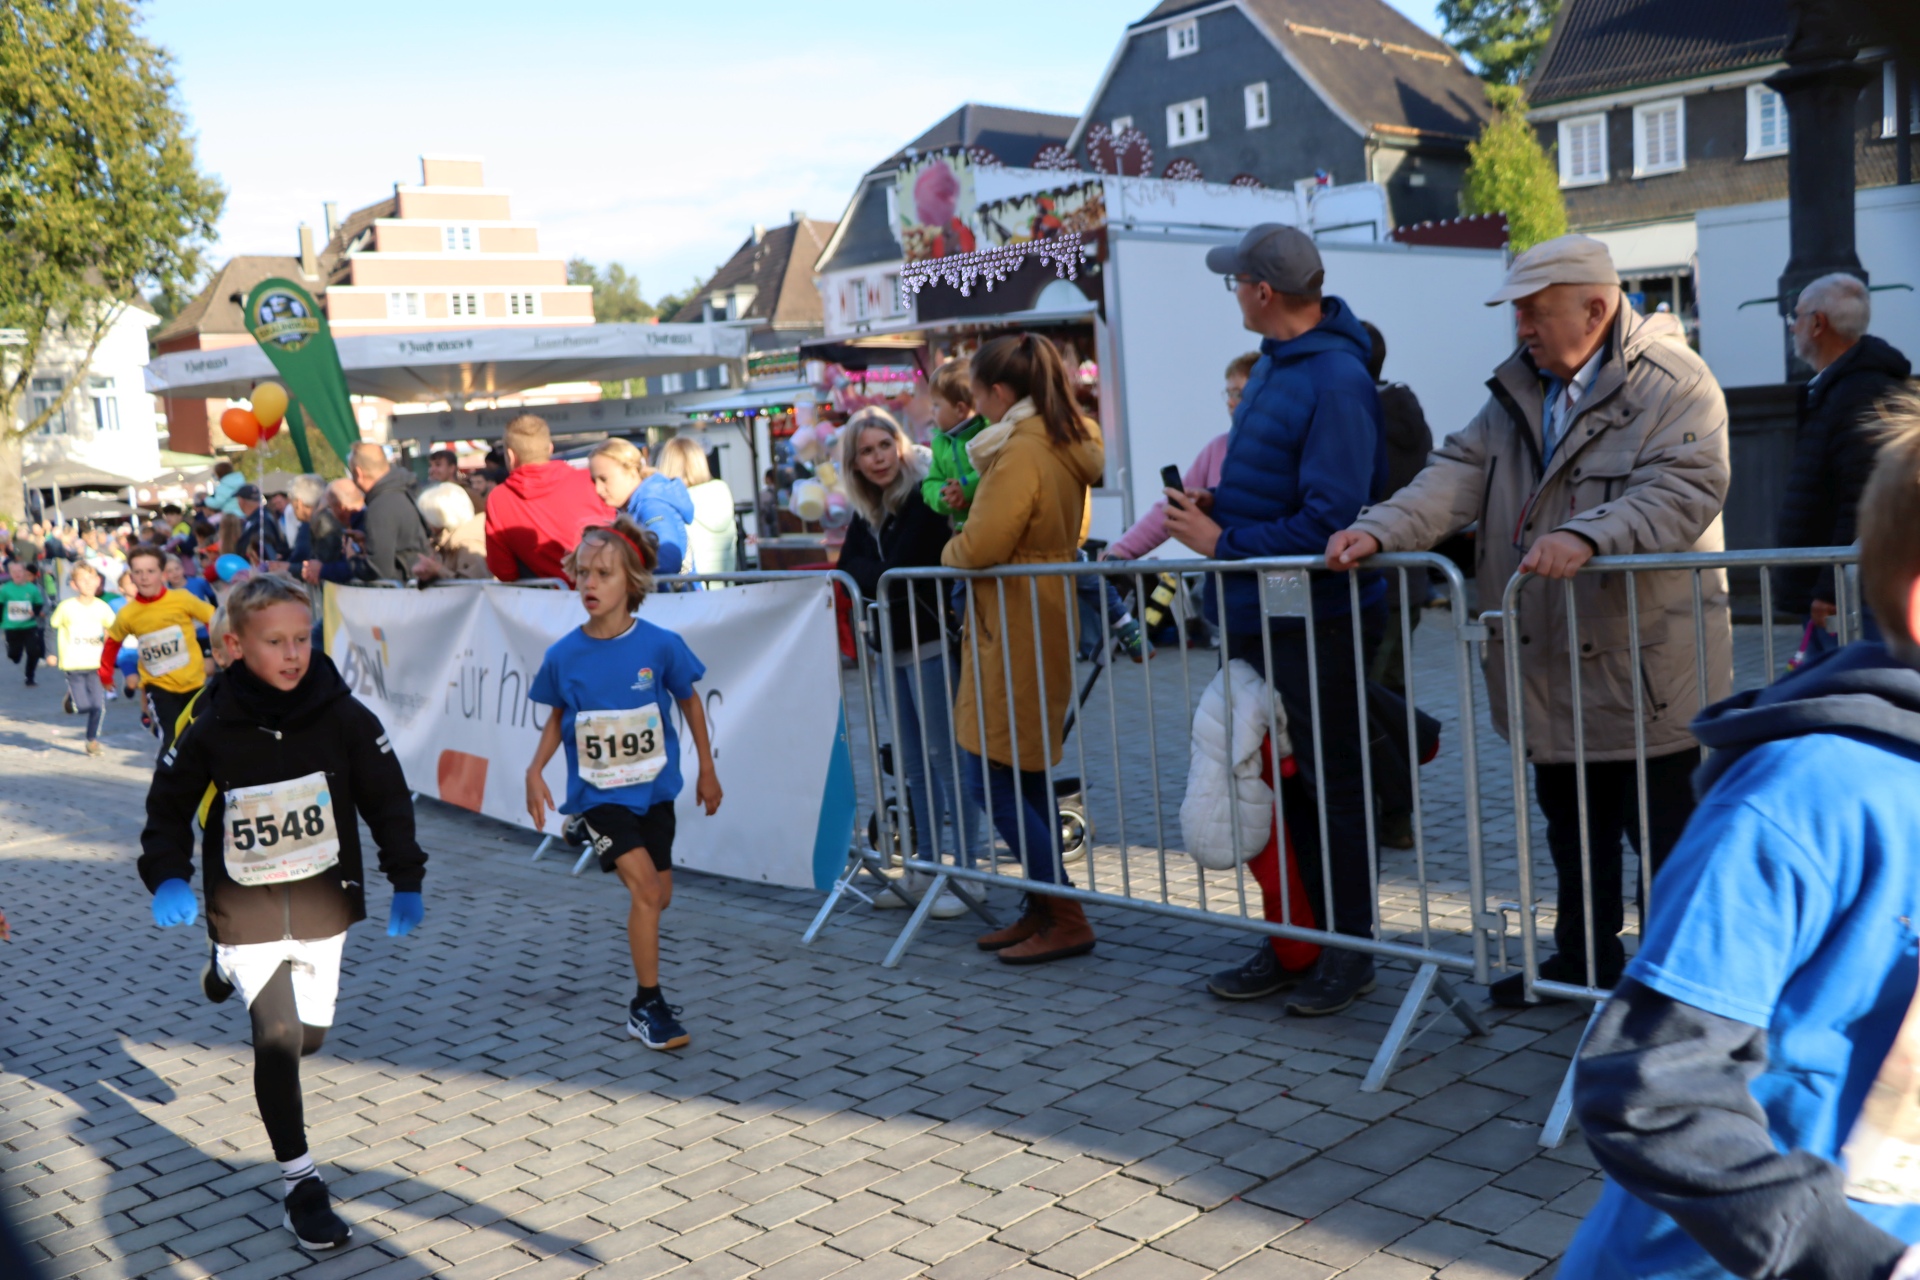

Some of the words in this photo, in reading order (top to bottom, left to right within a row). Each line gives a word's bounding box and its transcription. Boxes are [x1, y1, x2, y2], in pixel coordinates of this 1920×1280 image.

[141, 639, 179, 662] 5567
[343, 641, 388, 700] BEW
[444, 648, 489, 720] Für
[586, 729, 655, 760] 5193
[232, 805, 325, 850] 5548
[290, 867, 309, 876] BEW
